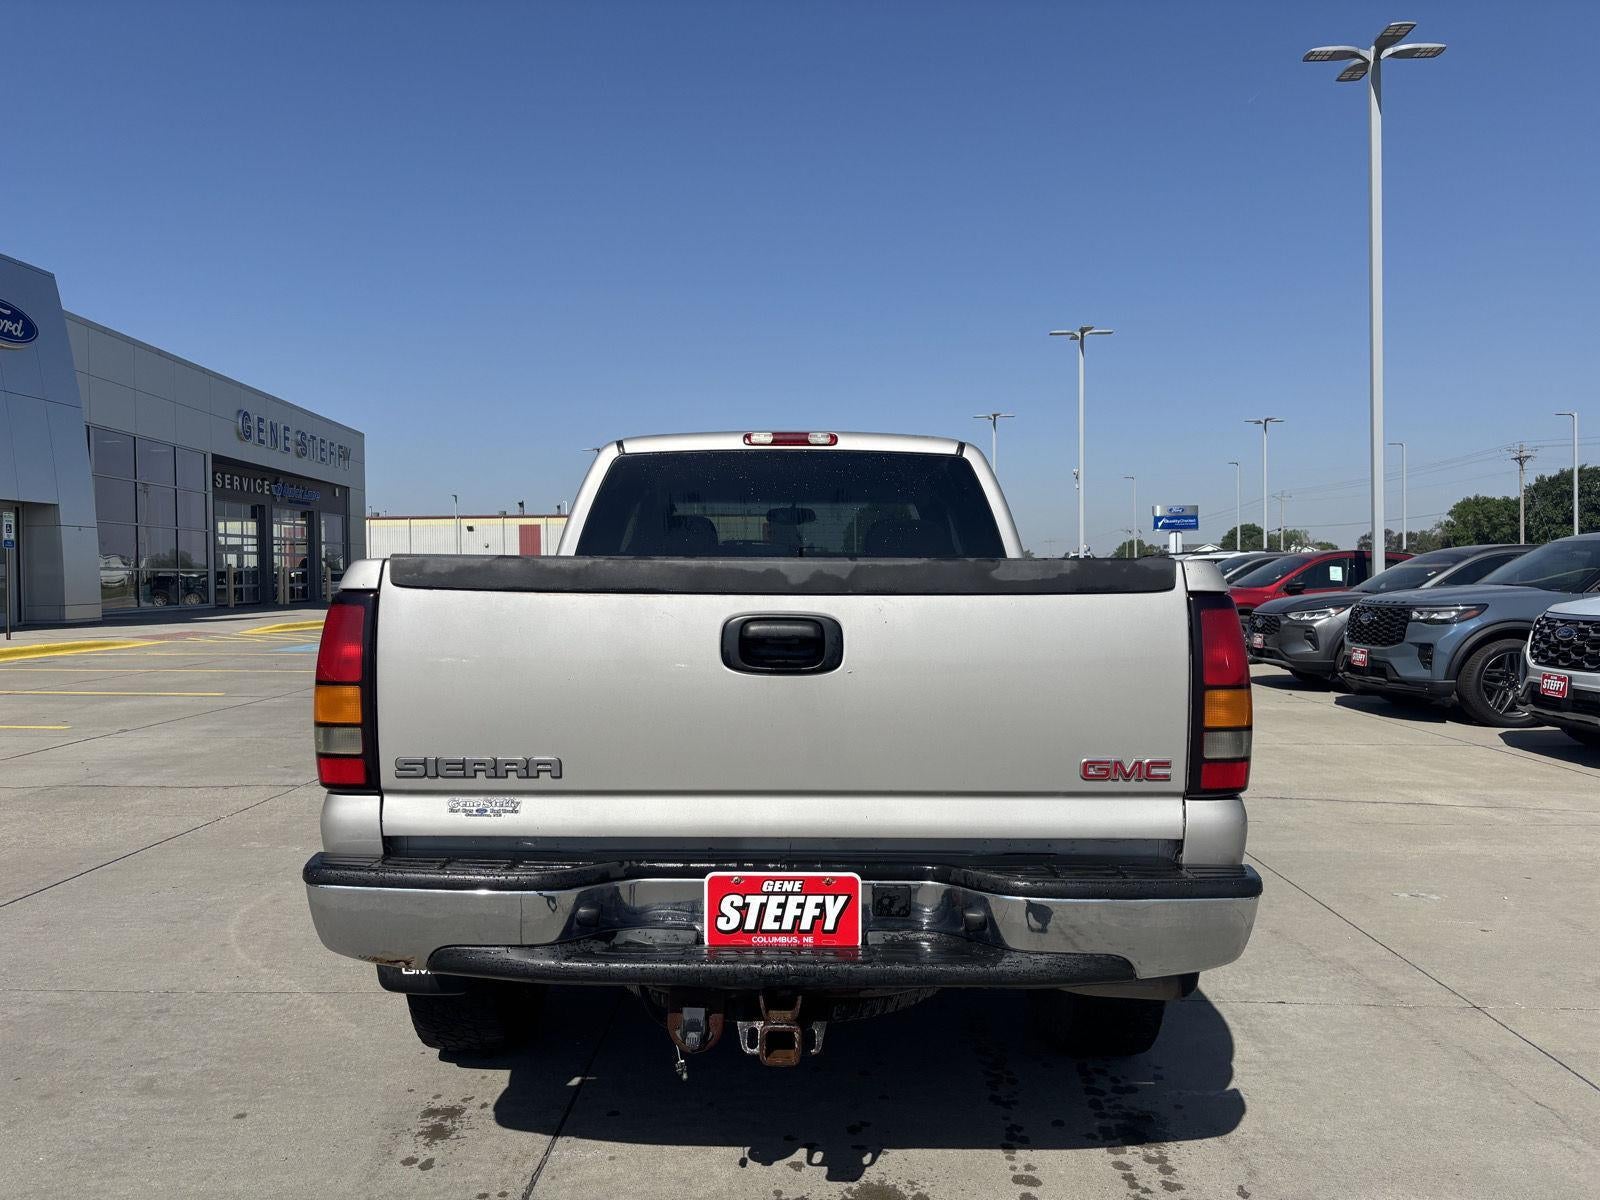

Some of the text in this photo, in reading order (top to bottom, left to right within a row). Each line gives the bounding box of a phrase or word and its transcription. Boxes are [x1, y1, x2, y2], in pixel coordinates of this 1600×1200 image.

[238, 410, 352, 471] GENE STEFFY
[215, 472, 270, 495] SERVICE
[1542, 678, 1565, 692] STEFFY
[395, 756, 562, 779] SIERRA
[1081, 759, 1172, 782] GMC
[448, 798, 481, 808] Gene
[761, 879, 804, 893] GENE
[715, 893, 851, 933] STEFFY
[751, 936, 814, 944] COLUMBUS, NE
